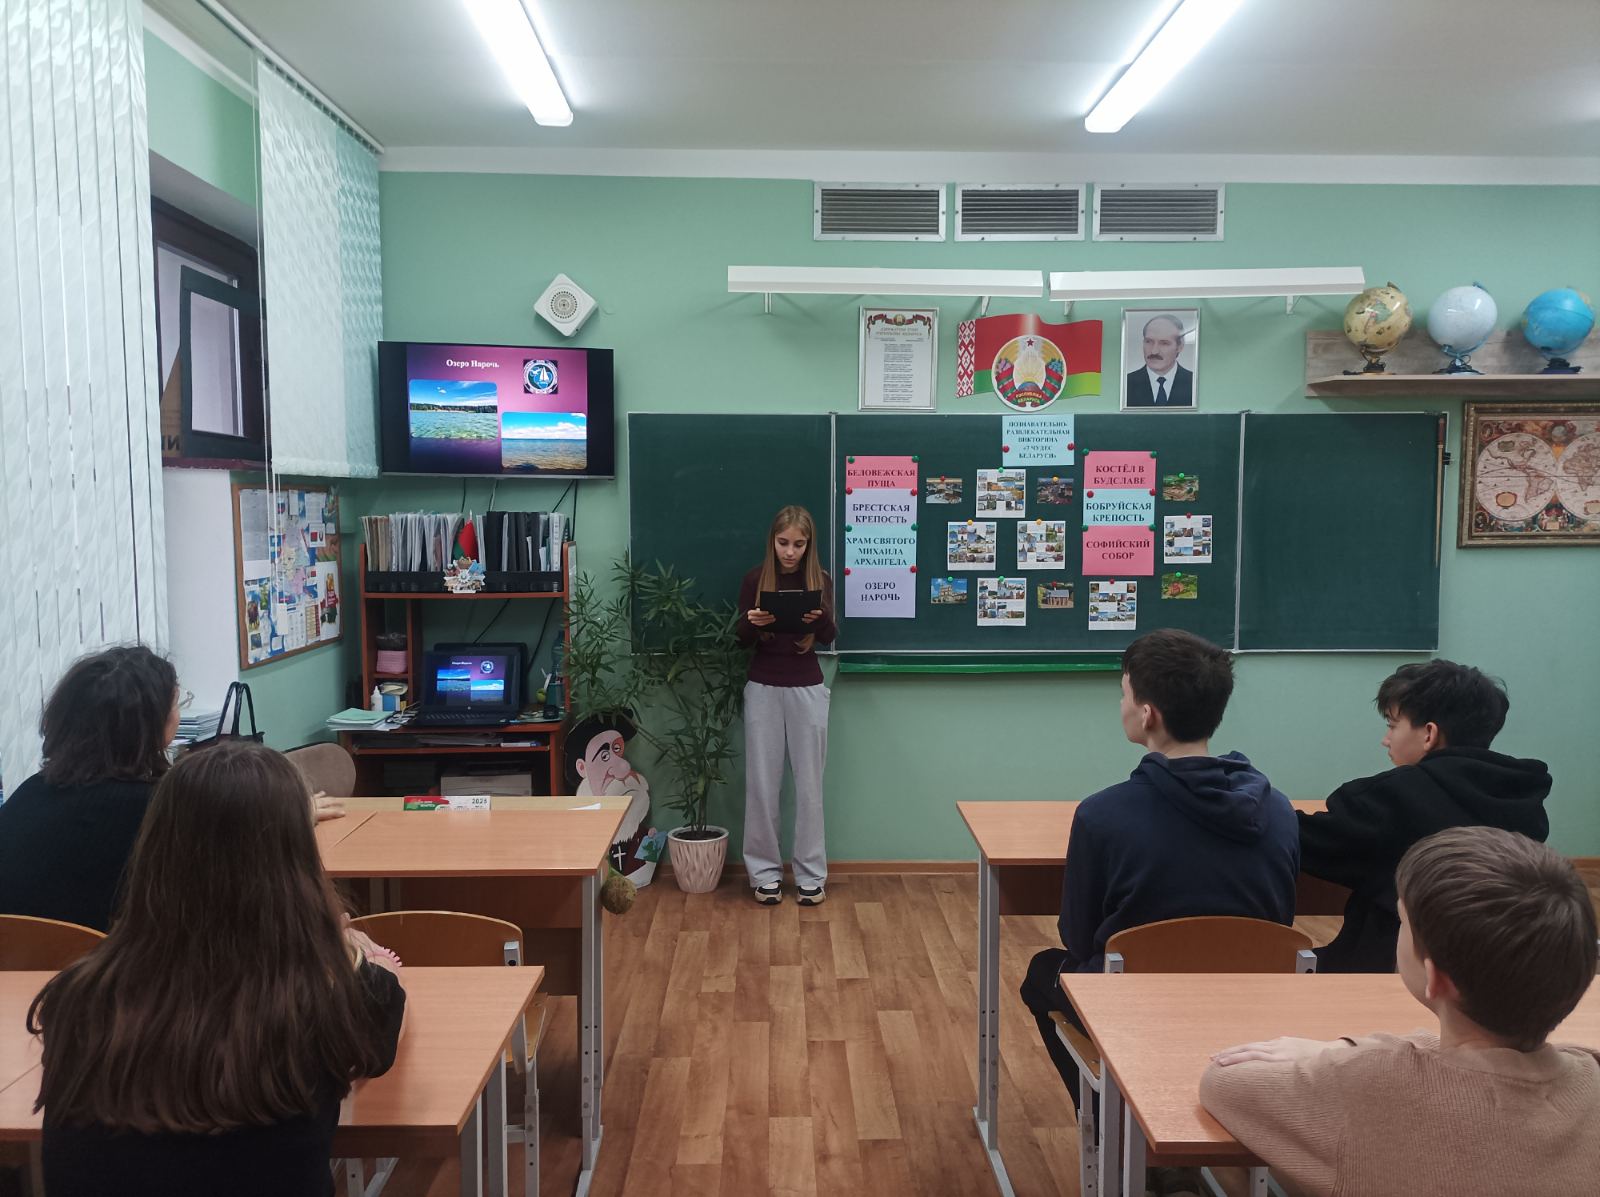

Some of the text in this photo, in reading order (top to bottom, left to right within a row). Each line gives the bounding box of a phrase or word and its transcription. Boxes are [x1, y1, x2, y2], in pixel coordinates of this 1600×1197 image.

[446, 359, 470, 368] Озеро
[1096, 464, 1136, 473] КОСТЁЛ
[847, 469, 915, 477] БЕЛОВЕЖСКАЯ
[867, 480, 896, 488] ПУЩА
[1094, 477, 1146, 485] БУДСЛАВЕ
[853, 504, 910, 512] БРЕСТСКАЯ
[1086, 501, 1152, 510] БОБРУЙСКАЯ
[855, 515, 907, 524] КРЕПОСТЬ
[1093, 514, 1145, 522] КРЕПОСТЬ
[847, 537, 915, 545] ХРАМ СВЯТОГО
[1086, 539, 1150, 549] СОФИЙСКИЙ
[858, 547, 903, 555] МИХАИЛА
[1102, 552, 1135, 560] СОБОР
[865, 582, 896, 590] ОЗЕРО
[861, 593, 900, 601] НАРОЧЬ
